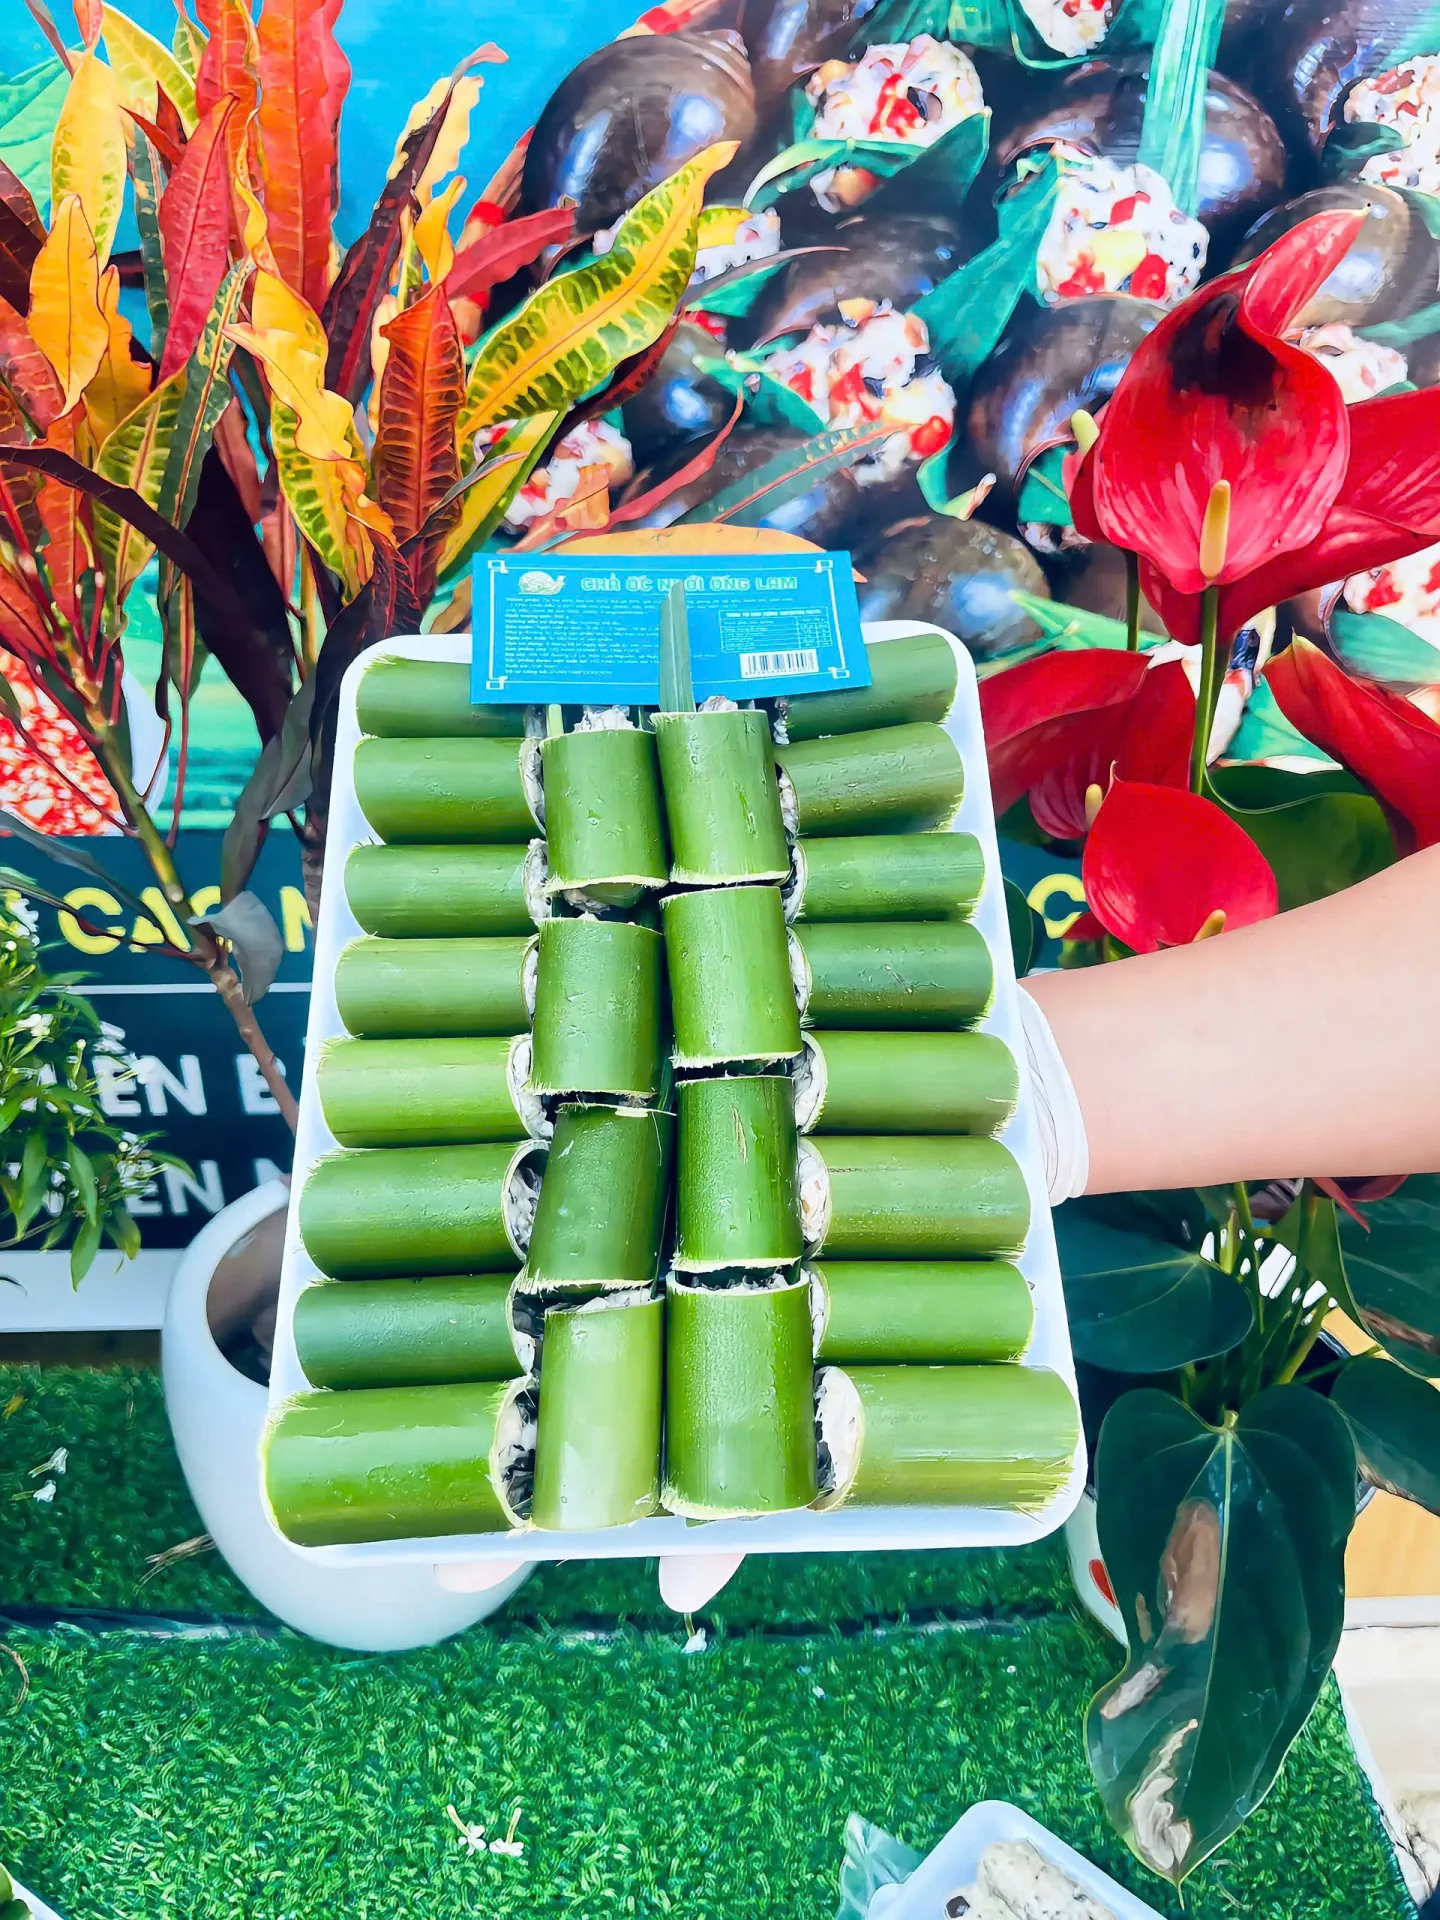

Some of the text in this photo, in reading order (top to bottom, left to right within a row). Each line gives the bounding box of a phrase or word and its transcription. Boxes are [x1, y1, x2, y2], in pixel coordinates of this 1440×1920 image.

[581, 572, 621, 591] CHẢ
[626, 574, 653, 591] ỐC
[710, 574, 750, 592] ỐNG
[755, 577, 798, 591] LAM
